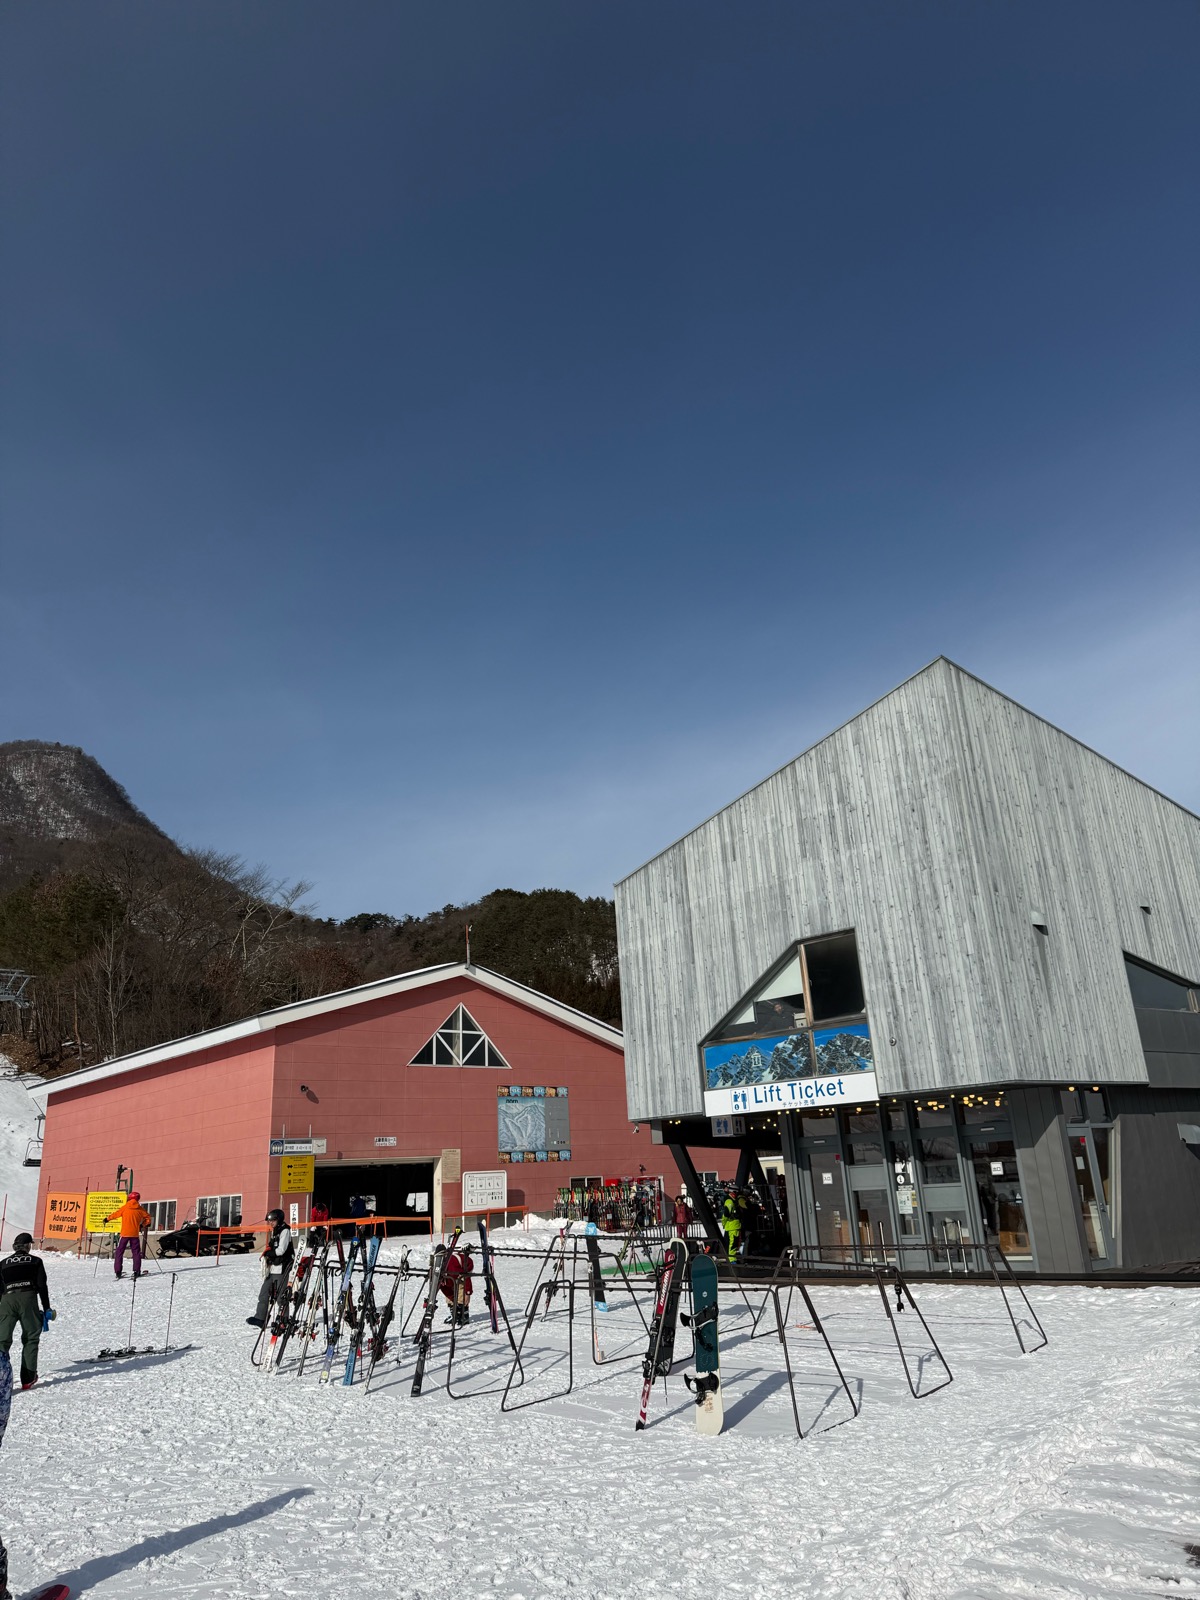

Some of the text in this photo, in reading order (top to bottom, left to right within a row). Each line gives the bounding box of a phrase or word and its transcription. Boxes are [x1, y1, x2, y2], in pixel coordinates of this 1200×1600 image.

[753, 1079, 844, 1103] Lift Ticket
[782, 1098, 816, 1108] チケット売場
[50, 1199, 81, 1212] 第1リフト
[52, 1214, 77, 1222] Advanced
[6, 1281, 31, 1290] INSTRUCTOR
